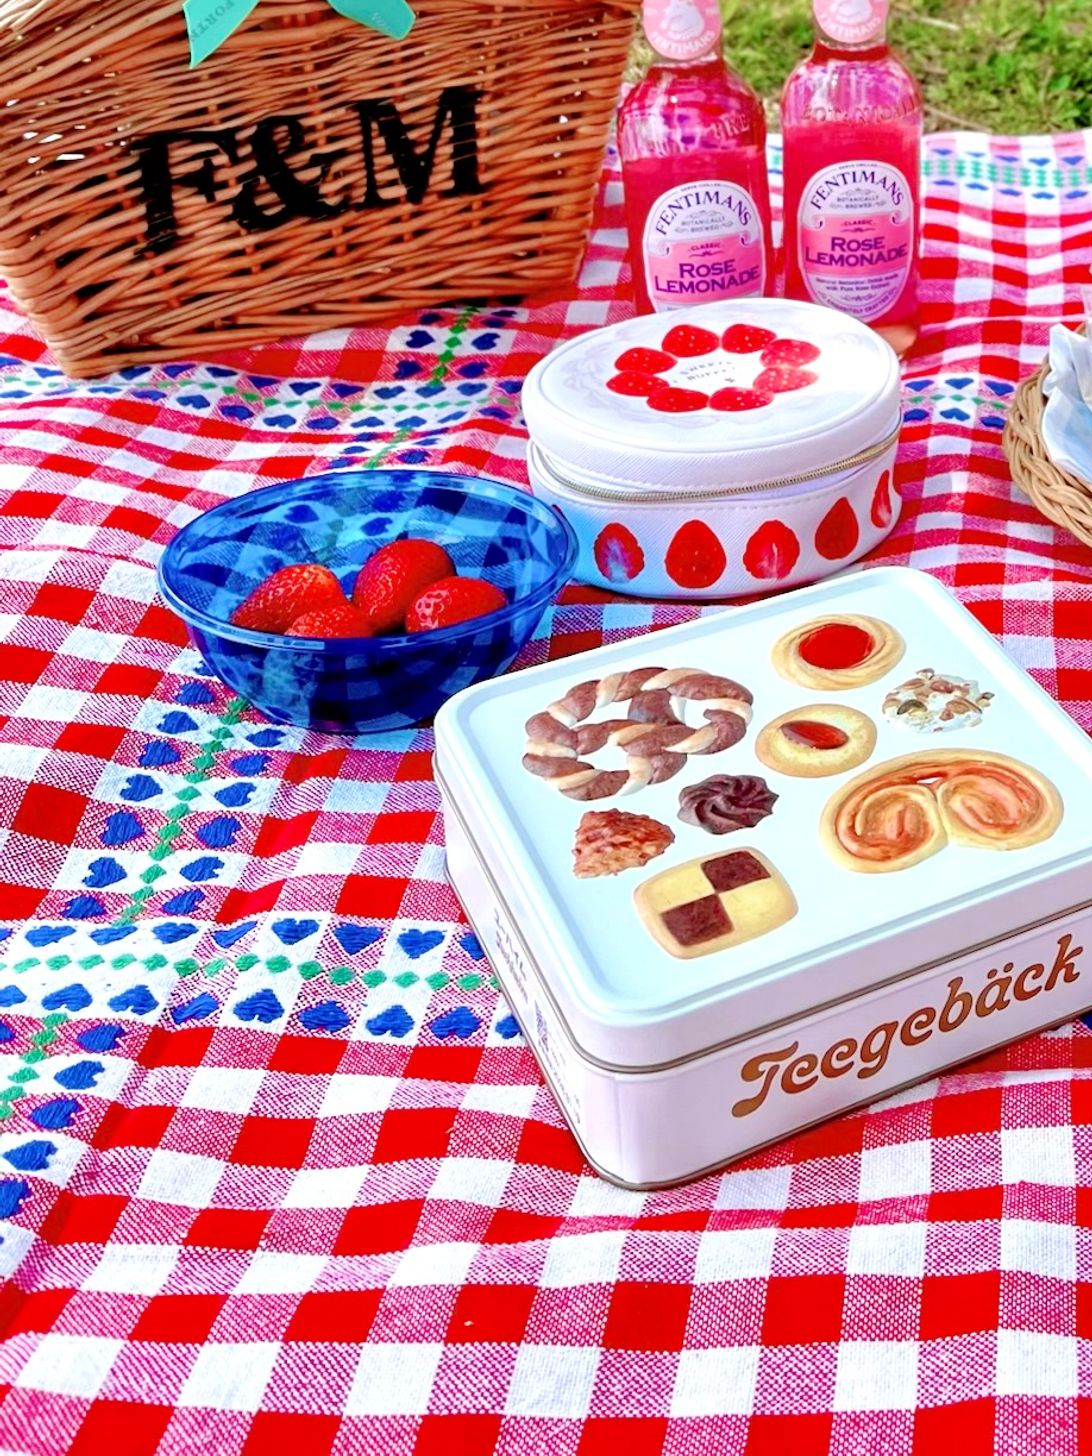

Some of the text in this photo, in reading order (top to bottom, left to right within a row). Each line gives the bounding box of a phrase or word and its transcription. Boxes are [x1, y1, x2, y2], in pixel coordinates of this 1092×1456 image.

[129, 86, 484, 253] F&M
[811, 170, 904, 210] FENTIMANS
[655, 190, 752, 236] FENTIMANS
[805, 242, 908, 267] LEMONADE
[831, 235, 885, 252] ROSE
[654, 264, 760, 294] LEMONADE
[679, 258, 737, 278] ROSE
[731, 933, 1084, 1118] Teegebäck
